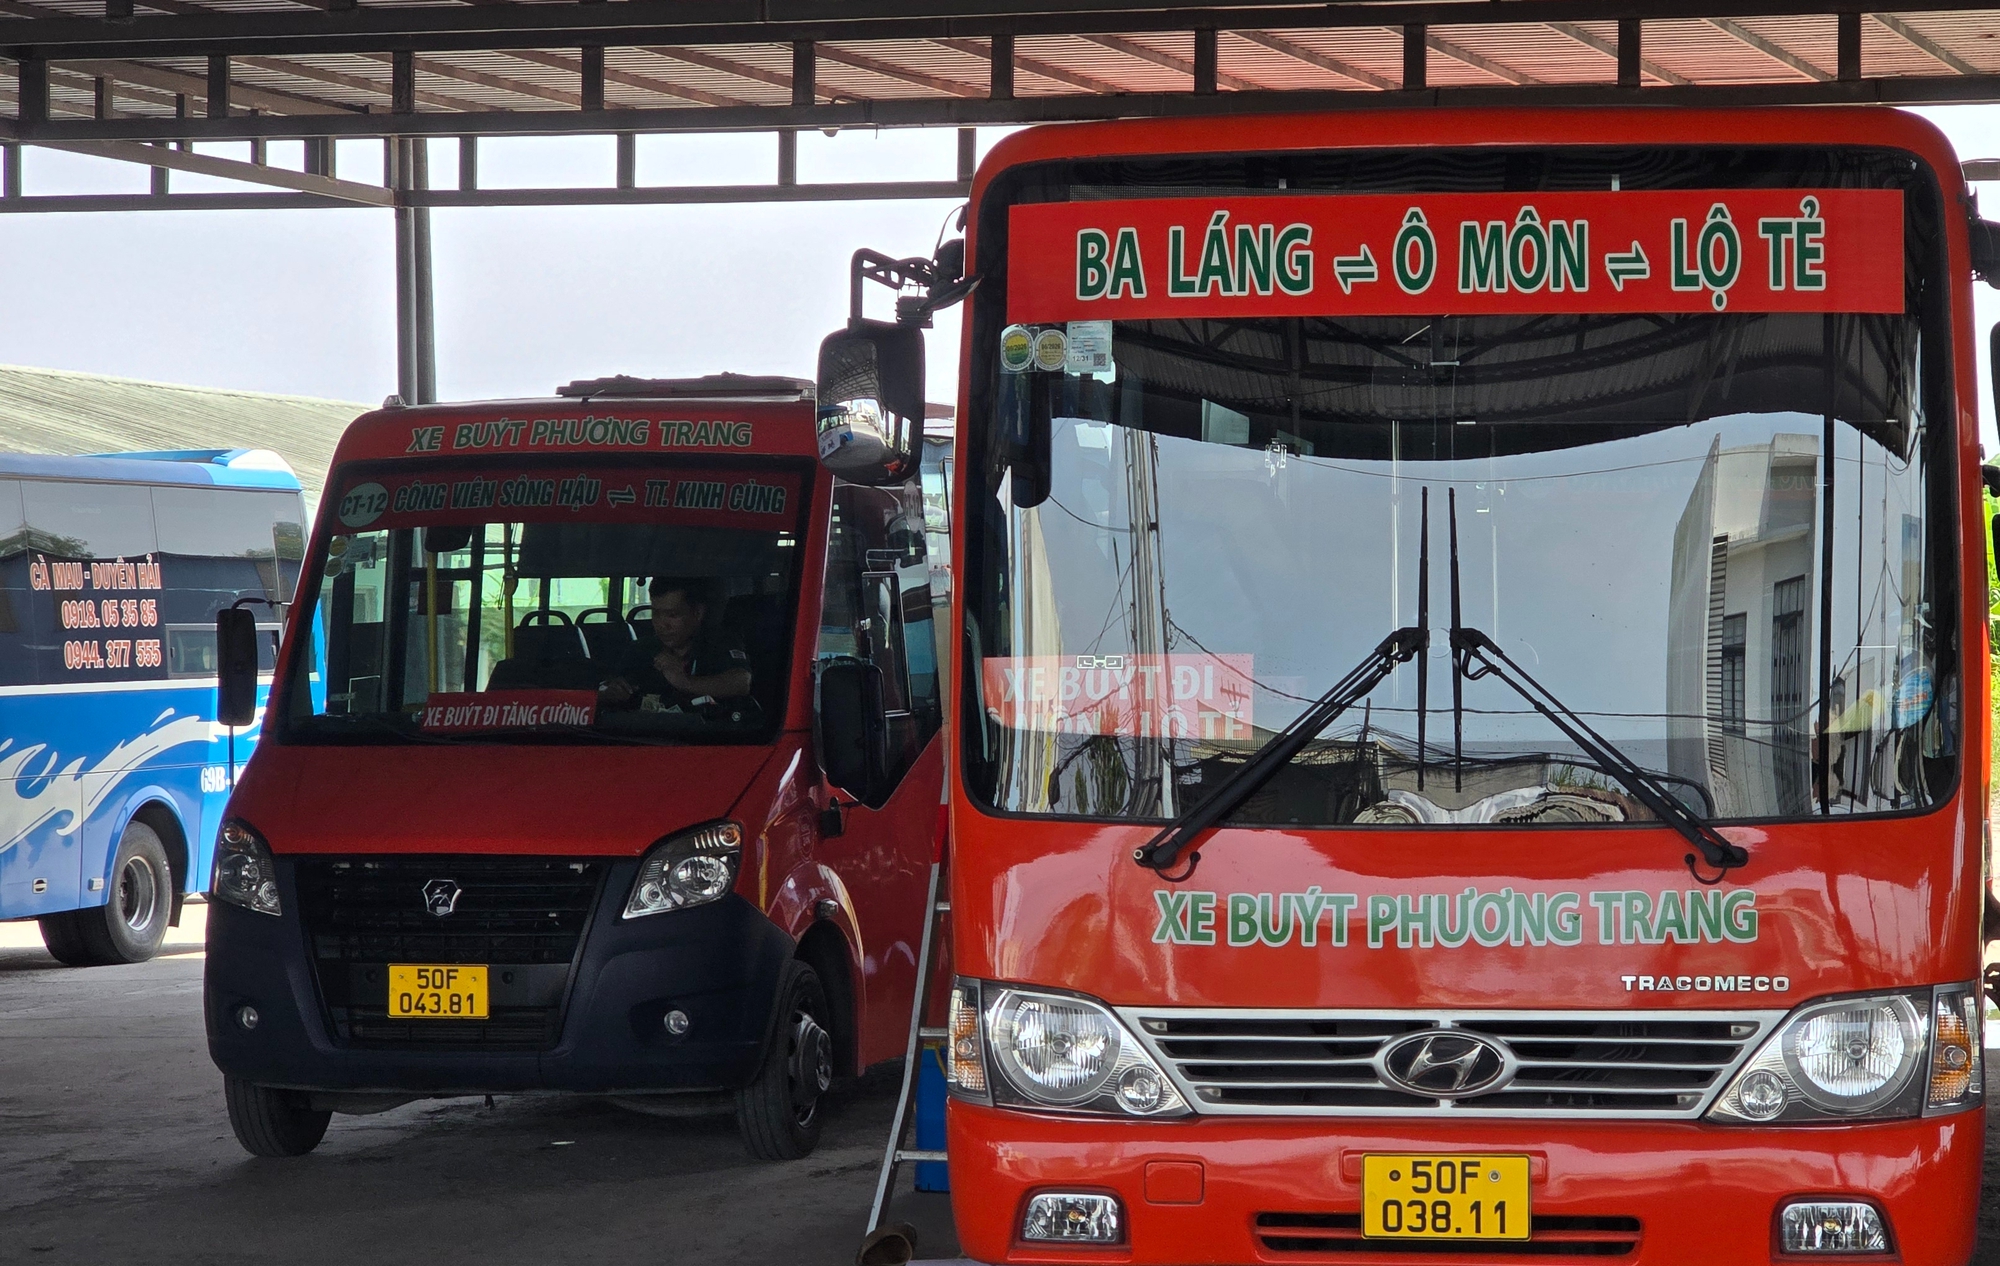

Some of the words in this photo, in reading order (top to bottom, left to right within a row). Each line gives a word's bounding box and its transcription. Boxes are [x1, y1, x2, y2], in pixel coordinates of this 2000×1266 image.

[1076, 228, 1147, 301] BA
[1168, 210, 1313, 297] LÁNG
[1392, 206, 1437, 295] Ô
[1458, 206, 1589, 293] MÔN
[1671, 203, 1742, 311] LỘ
[1758, 195, 1826, 291] TẺ
[406, 426, 444, 453] XE
[453, 417, 527, 449] BUÝT
[529, 416, 650, 446] PHƯƠNG
[659, 420, 752, 447] TRANG
[339, 492, 386, 517] CT-12
[392, 480, 448, 513] CÔNG
[450, 475, 497, 509] VIÊN
[499, 474, 556, 507] SÔNG
[556, 473, 601, 511] HẬU
[644, 480, 670, 507] TT.
[673, 481, 726, 509] KINH
[728, 479, 786, 514] CÙNG
[30, 554, 51, 590] CÀ
[51, 562, 83, 590] MAU
[91, 555, 136, 590] DUYÊN
[137, 553, 162, 589] HẢI
[61, 600, 100, 629] 0918.
[101, 599, 119, 628] 05
[121, 599, 139, 627] 35
[140, 599, 158, 627] 85
[64, 640, 104, 669] 0944.
[106, 640, 131, 668] 377
[135, 639, 162, 667] 555
[1004, 666, 1046, 702] XE
[1172, 665, 1213, 700] ĐI
[424, 706, 443, 727] XE
[444, 702, 482, 727] BUÝT
[483, 705, 500, 726] ĐI
[501, 701, 539, 726] TĂNG
[540, 702, 590, 725] CƯỜNG
[1152, 889, 1216, 946] XE
[1227, 885, 1358, 947] BUÝT
[1367, 887, 1583, 948] PHƯƠNG
[1589, 889, 1758, 944] TRANG
[417, 968, 459, 990] 50F
[1621, 975, 1790, 991] TRACOMECO
[399, 992, 474, 1014] 043.81
[1411, 1160, 1481, 1195] 50F
[1382, 1199, 1506, 1234] 038.11
